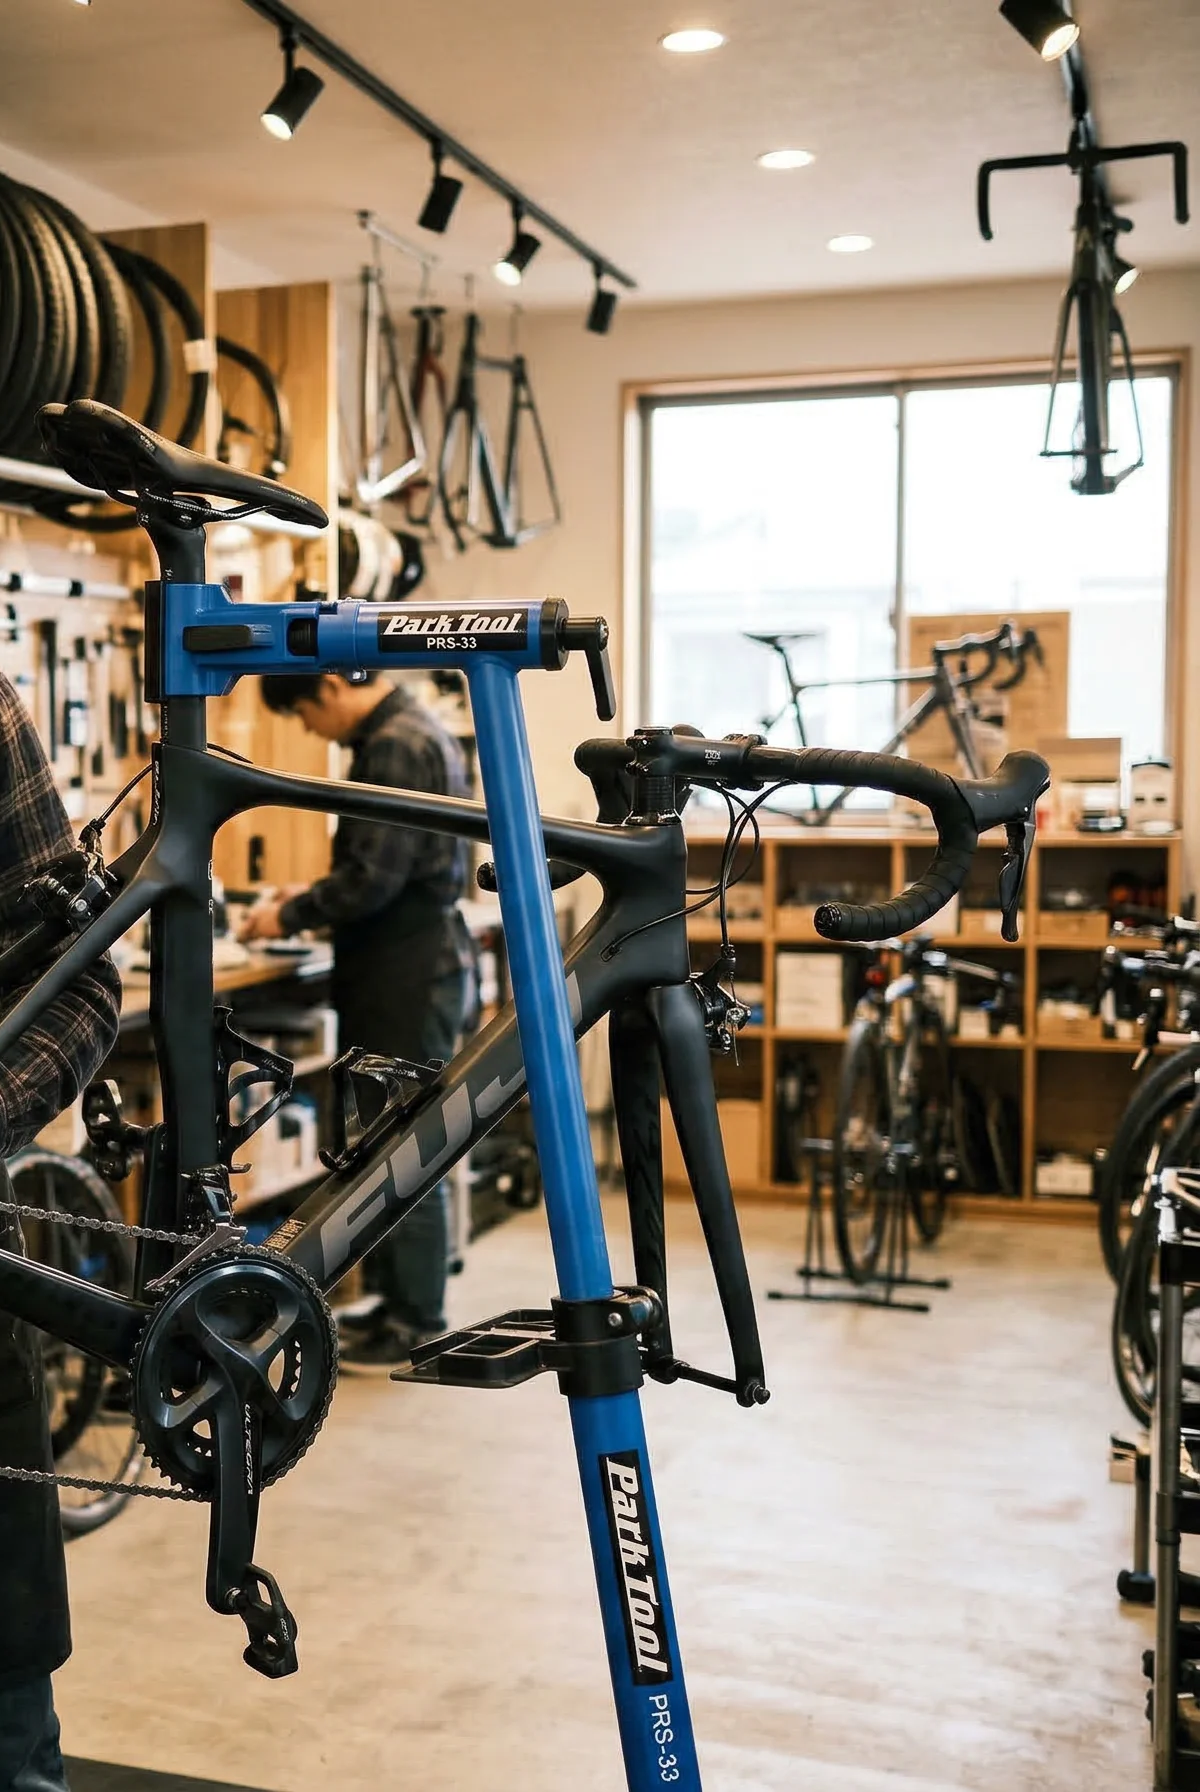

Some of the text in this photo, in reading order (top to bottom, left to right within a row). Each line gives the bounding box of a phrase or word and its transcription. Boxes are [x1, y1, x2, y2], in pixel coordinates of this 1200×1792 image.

[383, 612, 523, 635] Park Tool
[426, 636, 478, 650] PRS-33
[606, 1456, 668, 1674] Park Tool
[648, 1694, 680, 1783] PRS-33
